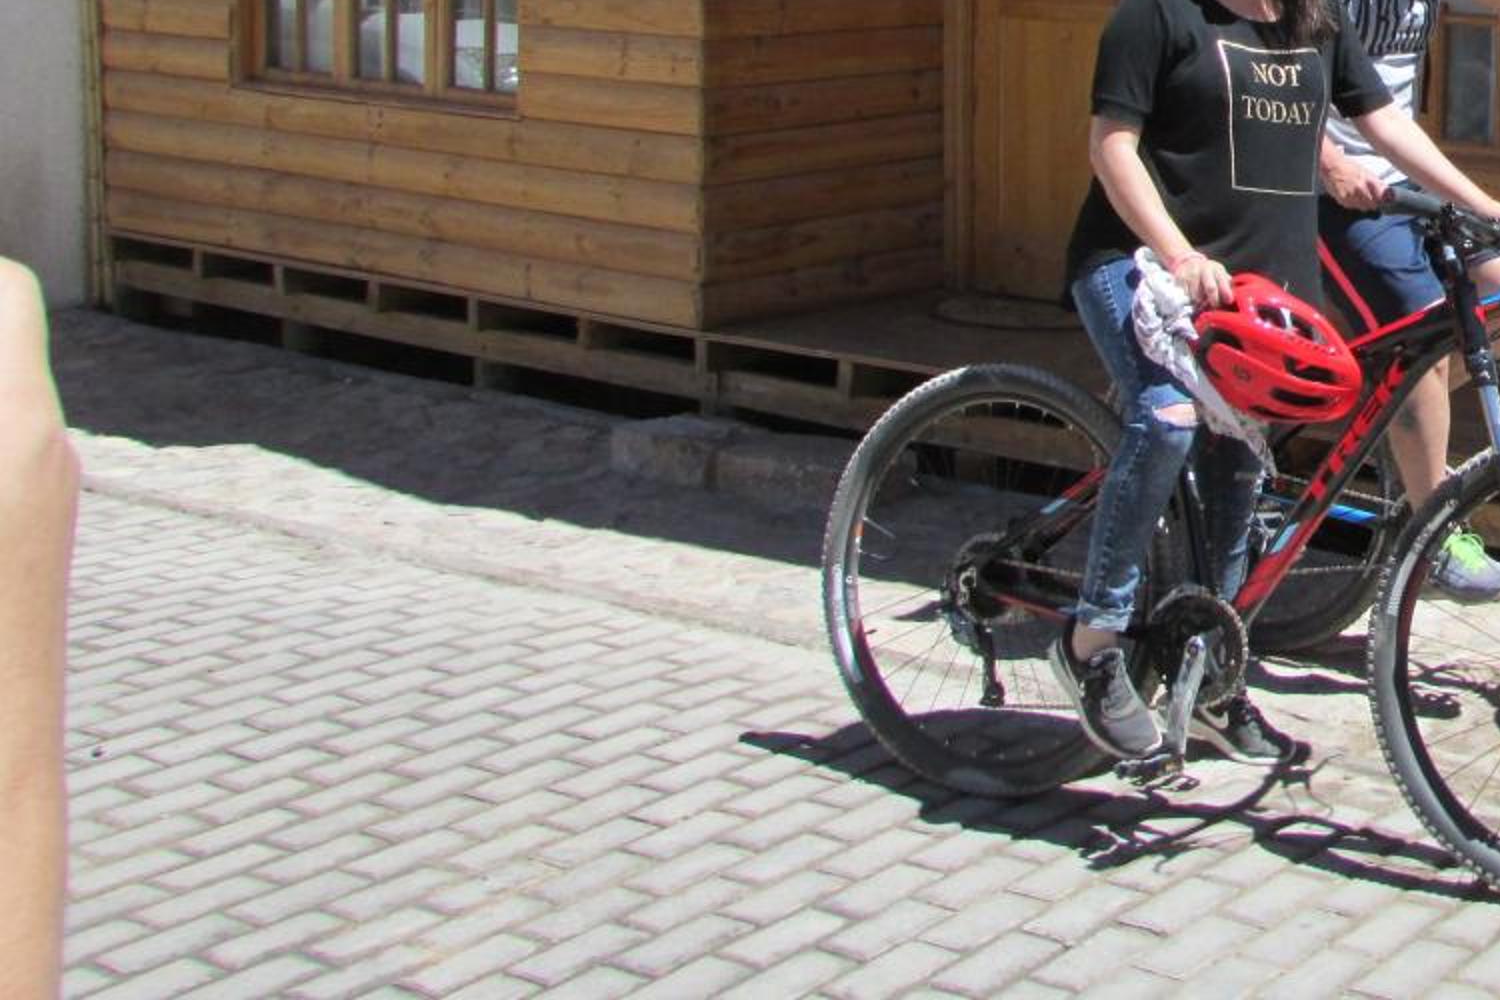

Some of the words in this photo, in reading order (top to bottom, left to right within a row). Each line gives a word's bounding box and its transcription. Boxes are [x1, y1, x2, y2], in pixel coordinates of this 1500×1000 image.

[1252, 62, 1302, 88] NOT
[1242, 95, 1316, 126] TODAY
[1303, 355, 1405, 502] TREK
